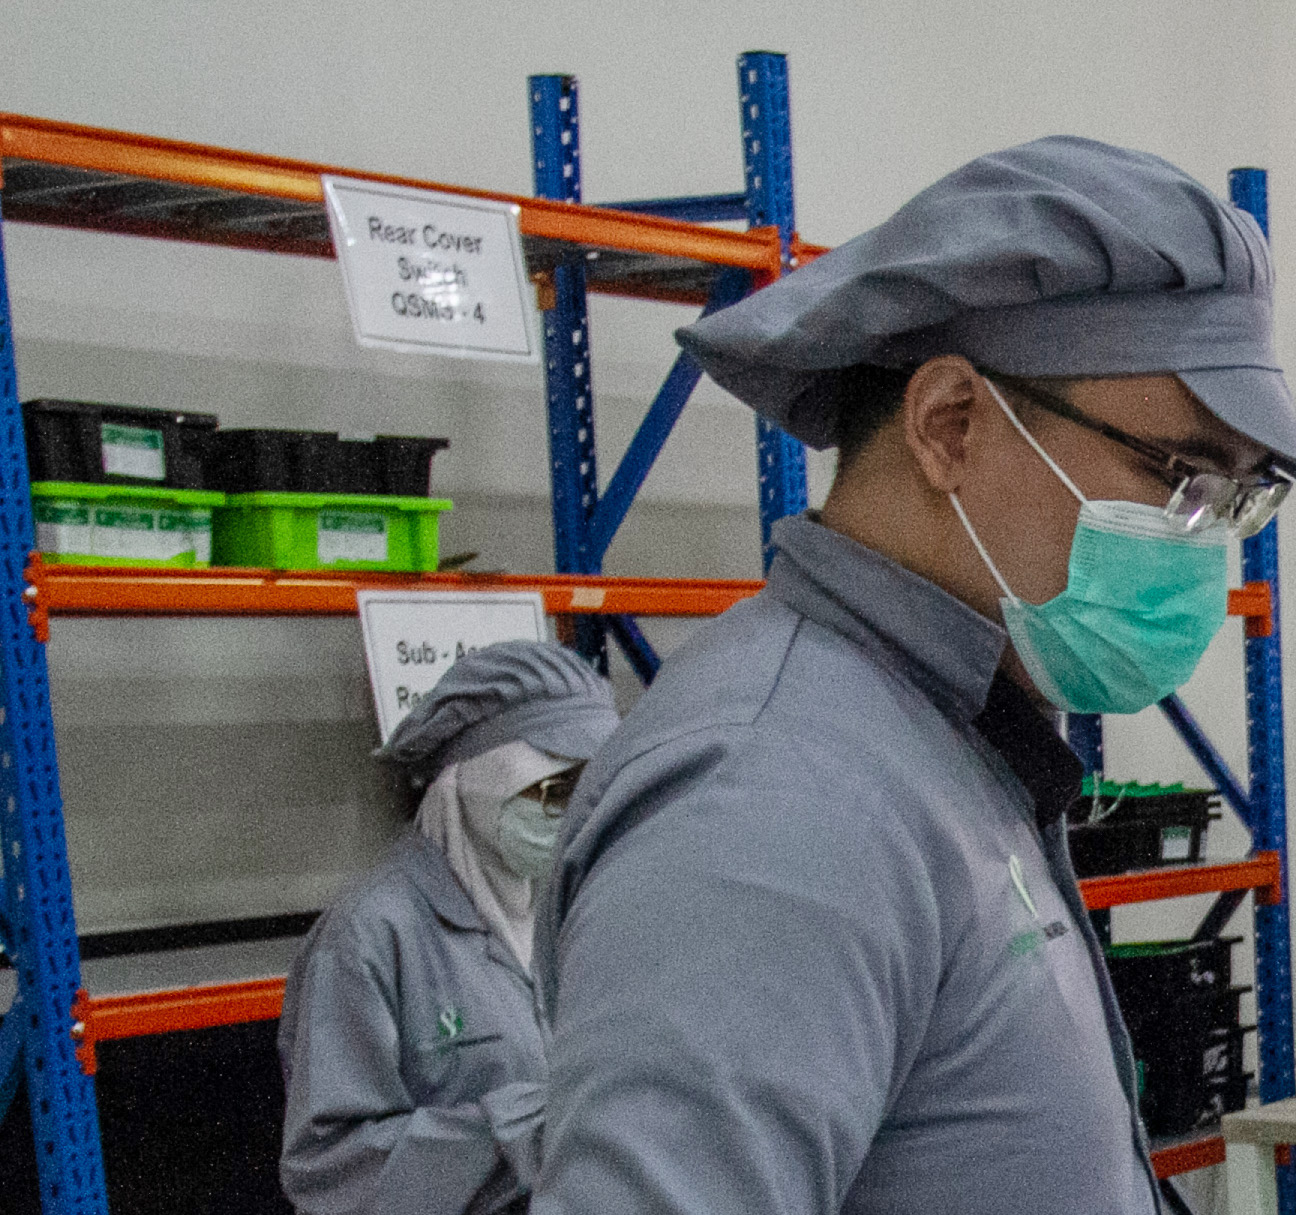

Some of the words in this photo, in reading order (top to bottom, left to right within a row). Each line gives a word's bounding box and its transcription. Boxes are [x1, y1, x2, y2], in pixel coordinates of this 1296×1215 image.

[368, 215, 417, 245] Rear
[422, 224, 483, 254] Cover
[473, 302, 486, 325] 4
[396, 640, 437, 665] Sub
